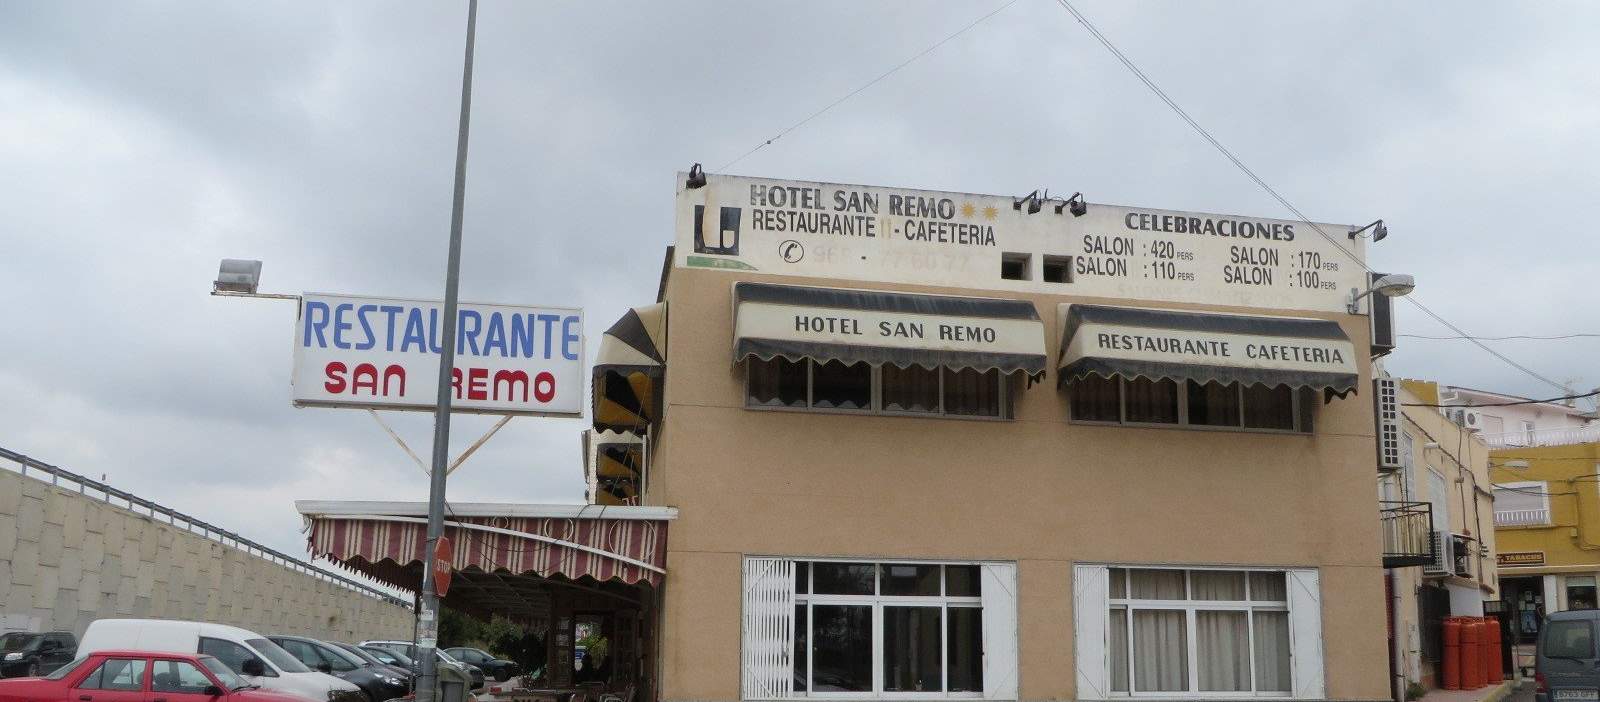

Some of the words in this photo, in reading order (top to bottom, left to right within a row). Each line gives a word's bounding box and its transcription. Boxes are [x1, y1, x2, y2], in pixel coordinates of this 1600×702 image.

[750, 184, 826, 210] HOTEL
[833, 190, 879, 215] SAN
[888, 194, 956, 220] REMO
[752, 209, 876, 238] RESTAURANTE
[904, 219, 996, 247] CAFETERIA
[1124, 212, 1295, 242] CELEBRACIONES
[1083, 234, 1134, 257] SALON
[1176, 252, 1194, 262] PERS
[1230, 245, 1279, 267] SALON
[1322, 262, 1339, 272] PERS
[1076, 255, 1128, 277] SALON
[1177, 272, 1195, 282] PERS
[1223, 265, 1273, 286] SALON
[1320, 281, 1337, 291] PERS
[794, 315, 863, 335] HOTEL
[878, 321, 924, 339] SAN
[939, 323, 997, 343] REMO
[1097, 332, 1231, 357] RESTAURANTE
[1246, 343, 1344, 364] CAFETERIA
[324, 361, 406, 397] SAN
[436, 558, 450, 574] STOP
